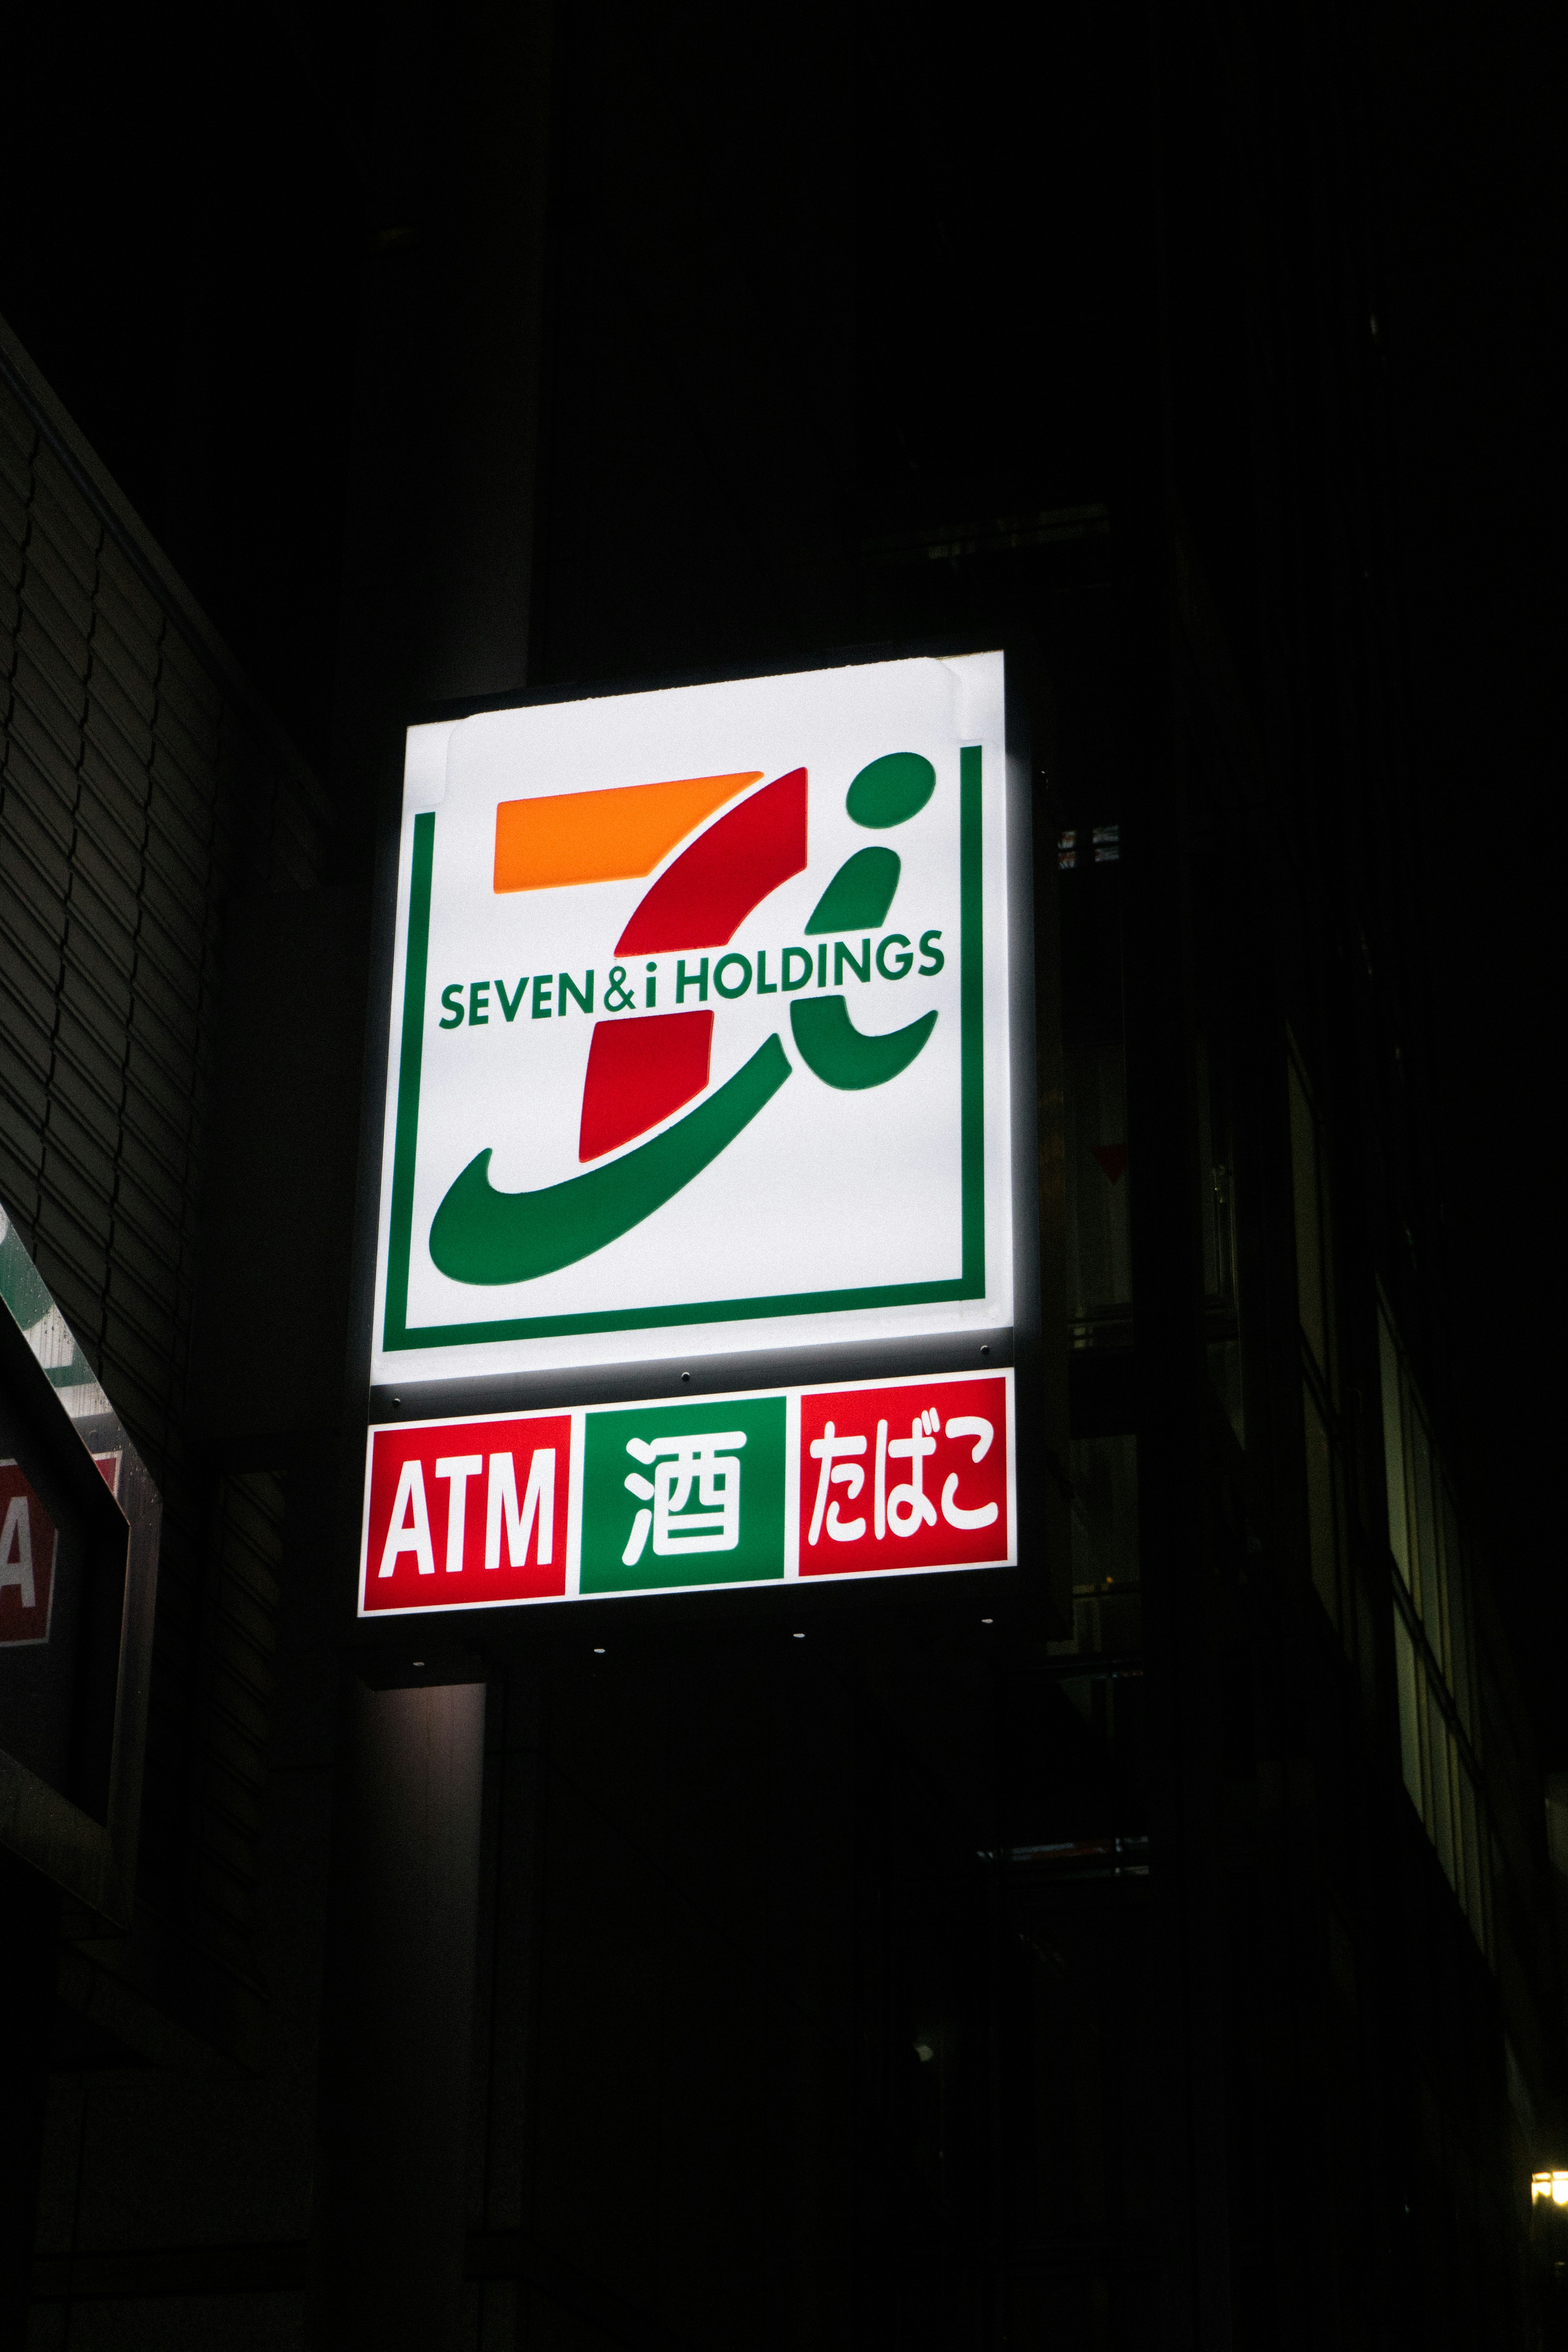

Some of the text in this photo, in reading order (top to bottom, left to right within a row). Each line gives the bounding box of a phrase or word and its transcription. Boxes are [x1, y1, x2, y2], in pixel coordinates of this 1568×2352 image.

[675, 929, 945, 1004] HOLDINGS
[378, 1448, 556, 1578] ATM
[622, 1431, 747, 1566] 酒
[808, 1407, 998, 1546] たばこ
